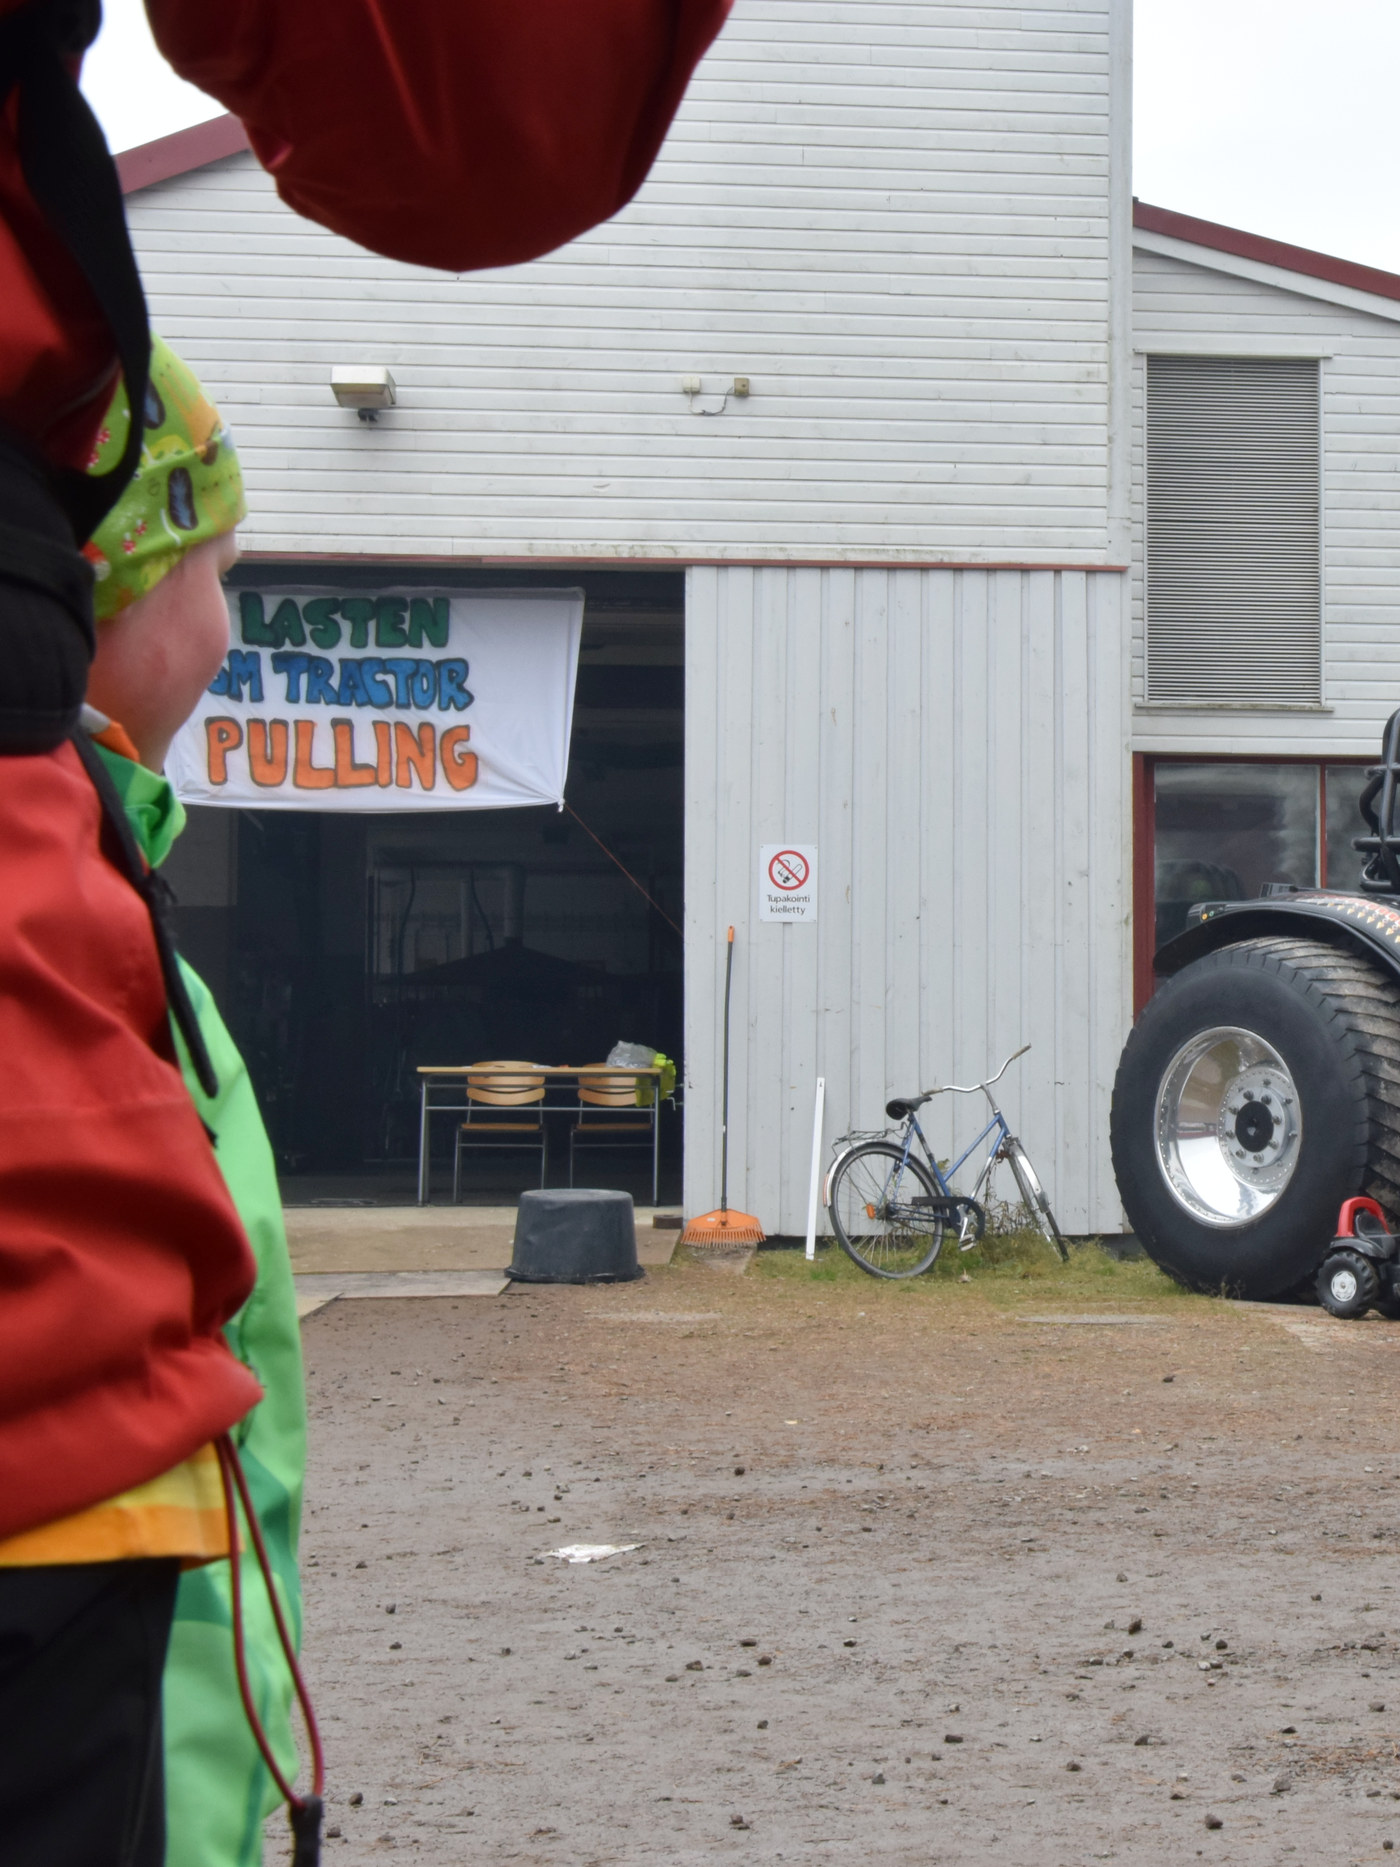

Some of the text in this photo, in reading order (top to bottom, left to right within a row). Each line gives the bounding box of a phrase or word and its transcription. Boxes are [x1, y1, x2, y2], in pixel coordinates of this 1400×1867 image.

[239, 591, 450, 649] LASTEN
[271, 651, 475, 711] TRACTOR
[204, 716, 478, 791] PULLING
[767, 894, 811, 904] Tupakointi
[770, 905, 806, 916] kielletty
